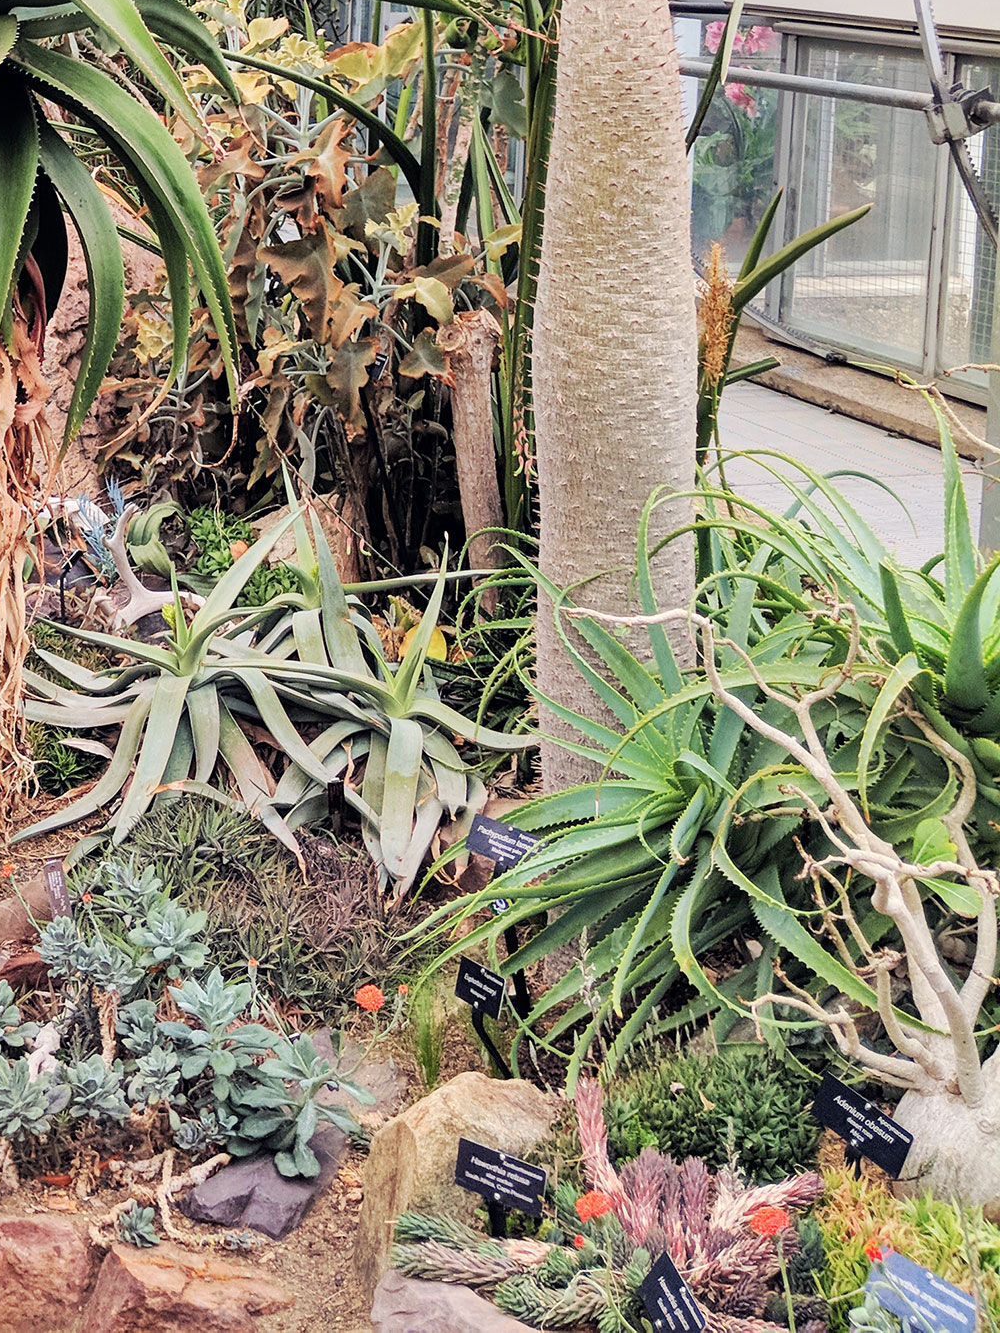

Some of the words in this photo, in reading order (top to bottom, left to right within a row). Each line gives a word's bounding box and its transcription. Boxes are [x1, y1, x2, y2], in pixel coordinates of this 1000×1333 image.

[477, 824, 517, 846] Pachypodium
[833, 1095, 866, 1122] Adenium
[864, 1119, 895, 1145] obesum
